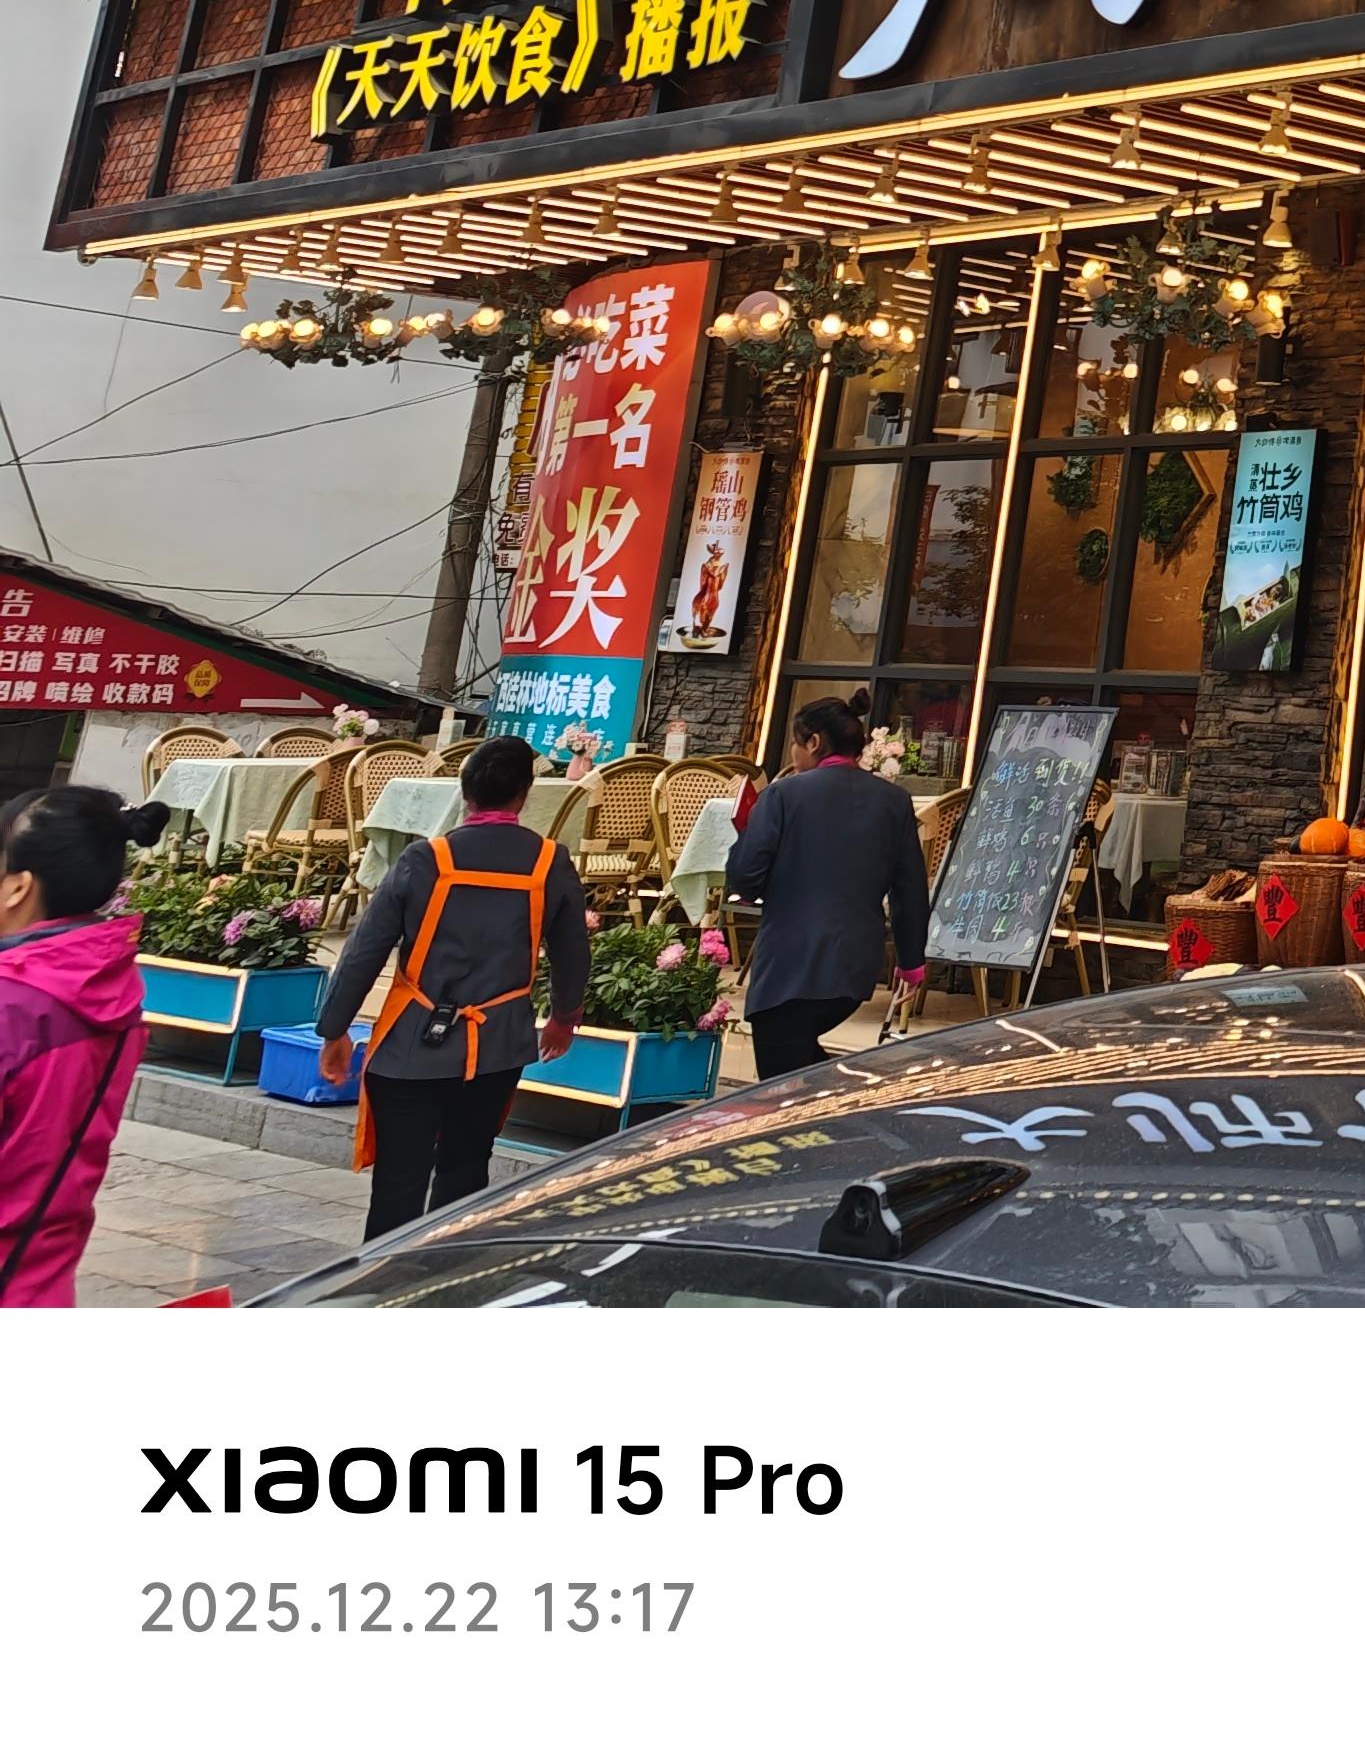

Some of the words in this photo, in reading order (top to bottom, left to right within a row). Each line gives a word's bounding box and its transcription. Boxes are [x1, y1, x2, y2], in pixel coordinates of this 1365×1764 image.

[1260, 461, 1303, 492] 壮乡
[1236, 491, 1304, 524] 竹筒鸡
[60, 626, 106, 645] 维修
[51, 652, 101, 674] 写真
[108, 653, 181, 677] 不干胶
[45, 682, 95, 704] 喷绘
[102, 683, 175, 705] 收款码
[1020, 830, 1033, 846] 6
[1006, 859, 1021, 878] 4
[990, 915, 1007, 937] 4
